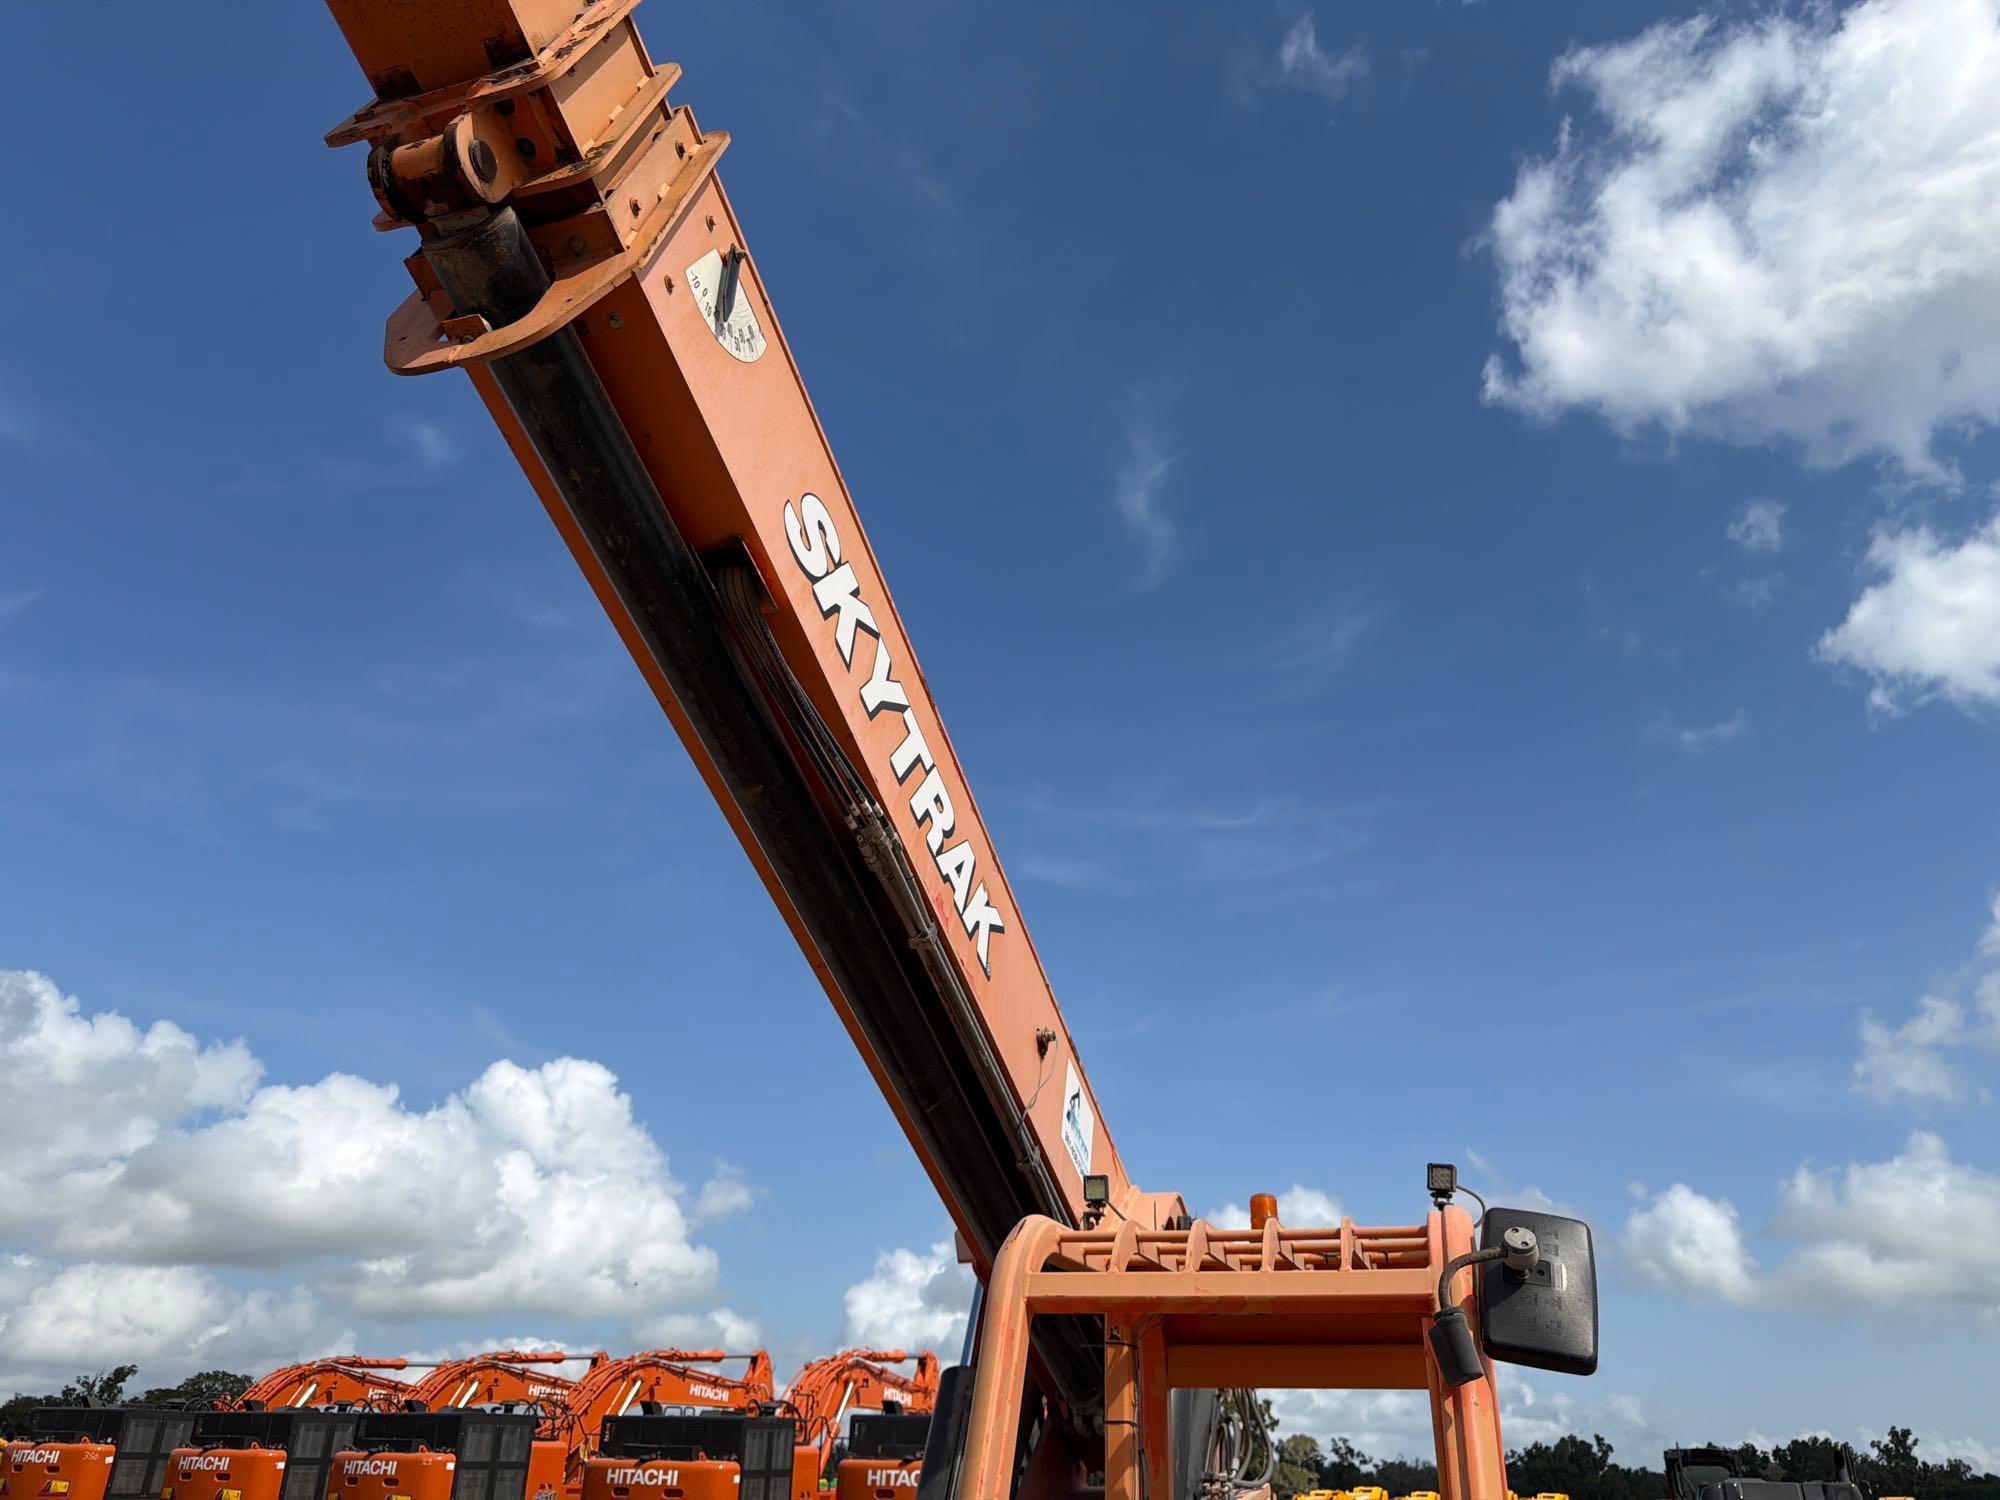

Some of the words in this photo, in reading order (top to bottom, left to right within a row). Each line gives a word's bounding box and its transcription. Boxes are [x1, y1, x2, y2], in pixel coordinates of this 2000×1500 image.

[783, 491, 1006, 983] SKYTRAK
[689, 1382, 730, 1403] HITACHI
[10, 1448, 60, 1464] HITACHI
[177, 1456, 230, 1471] HITACHI
[342, 1460, 398, 1476] HITACHI
[605, 1467, 679, 1487] HITACHI
